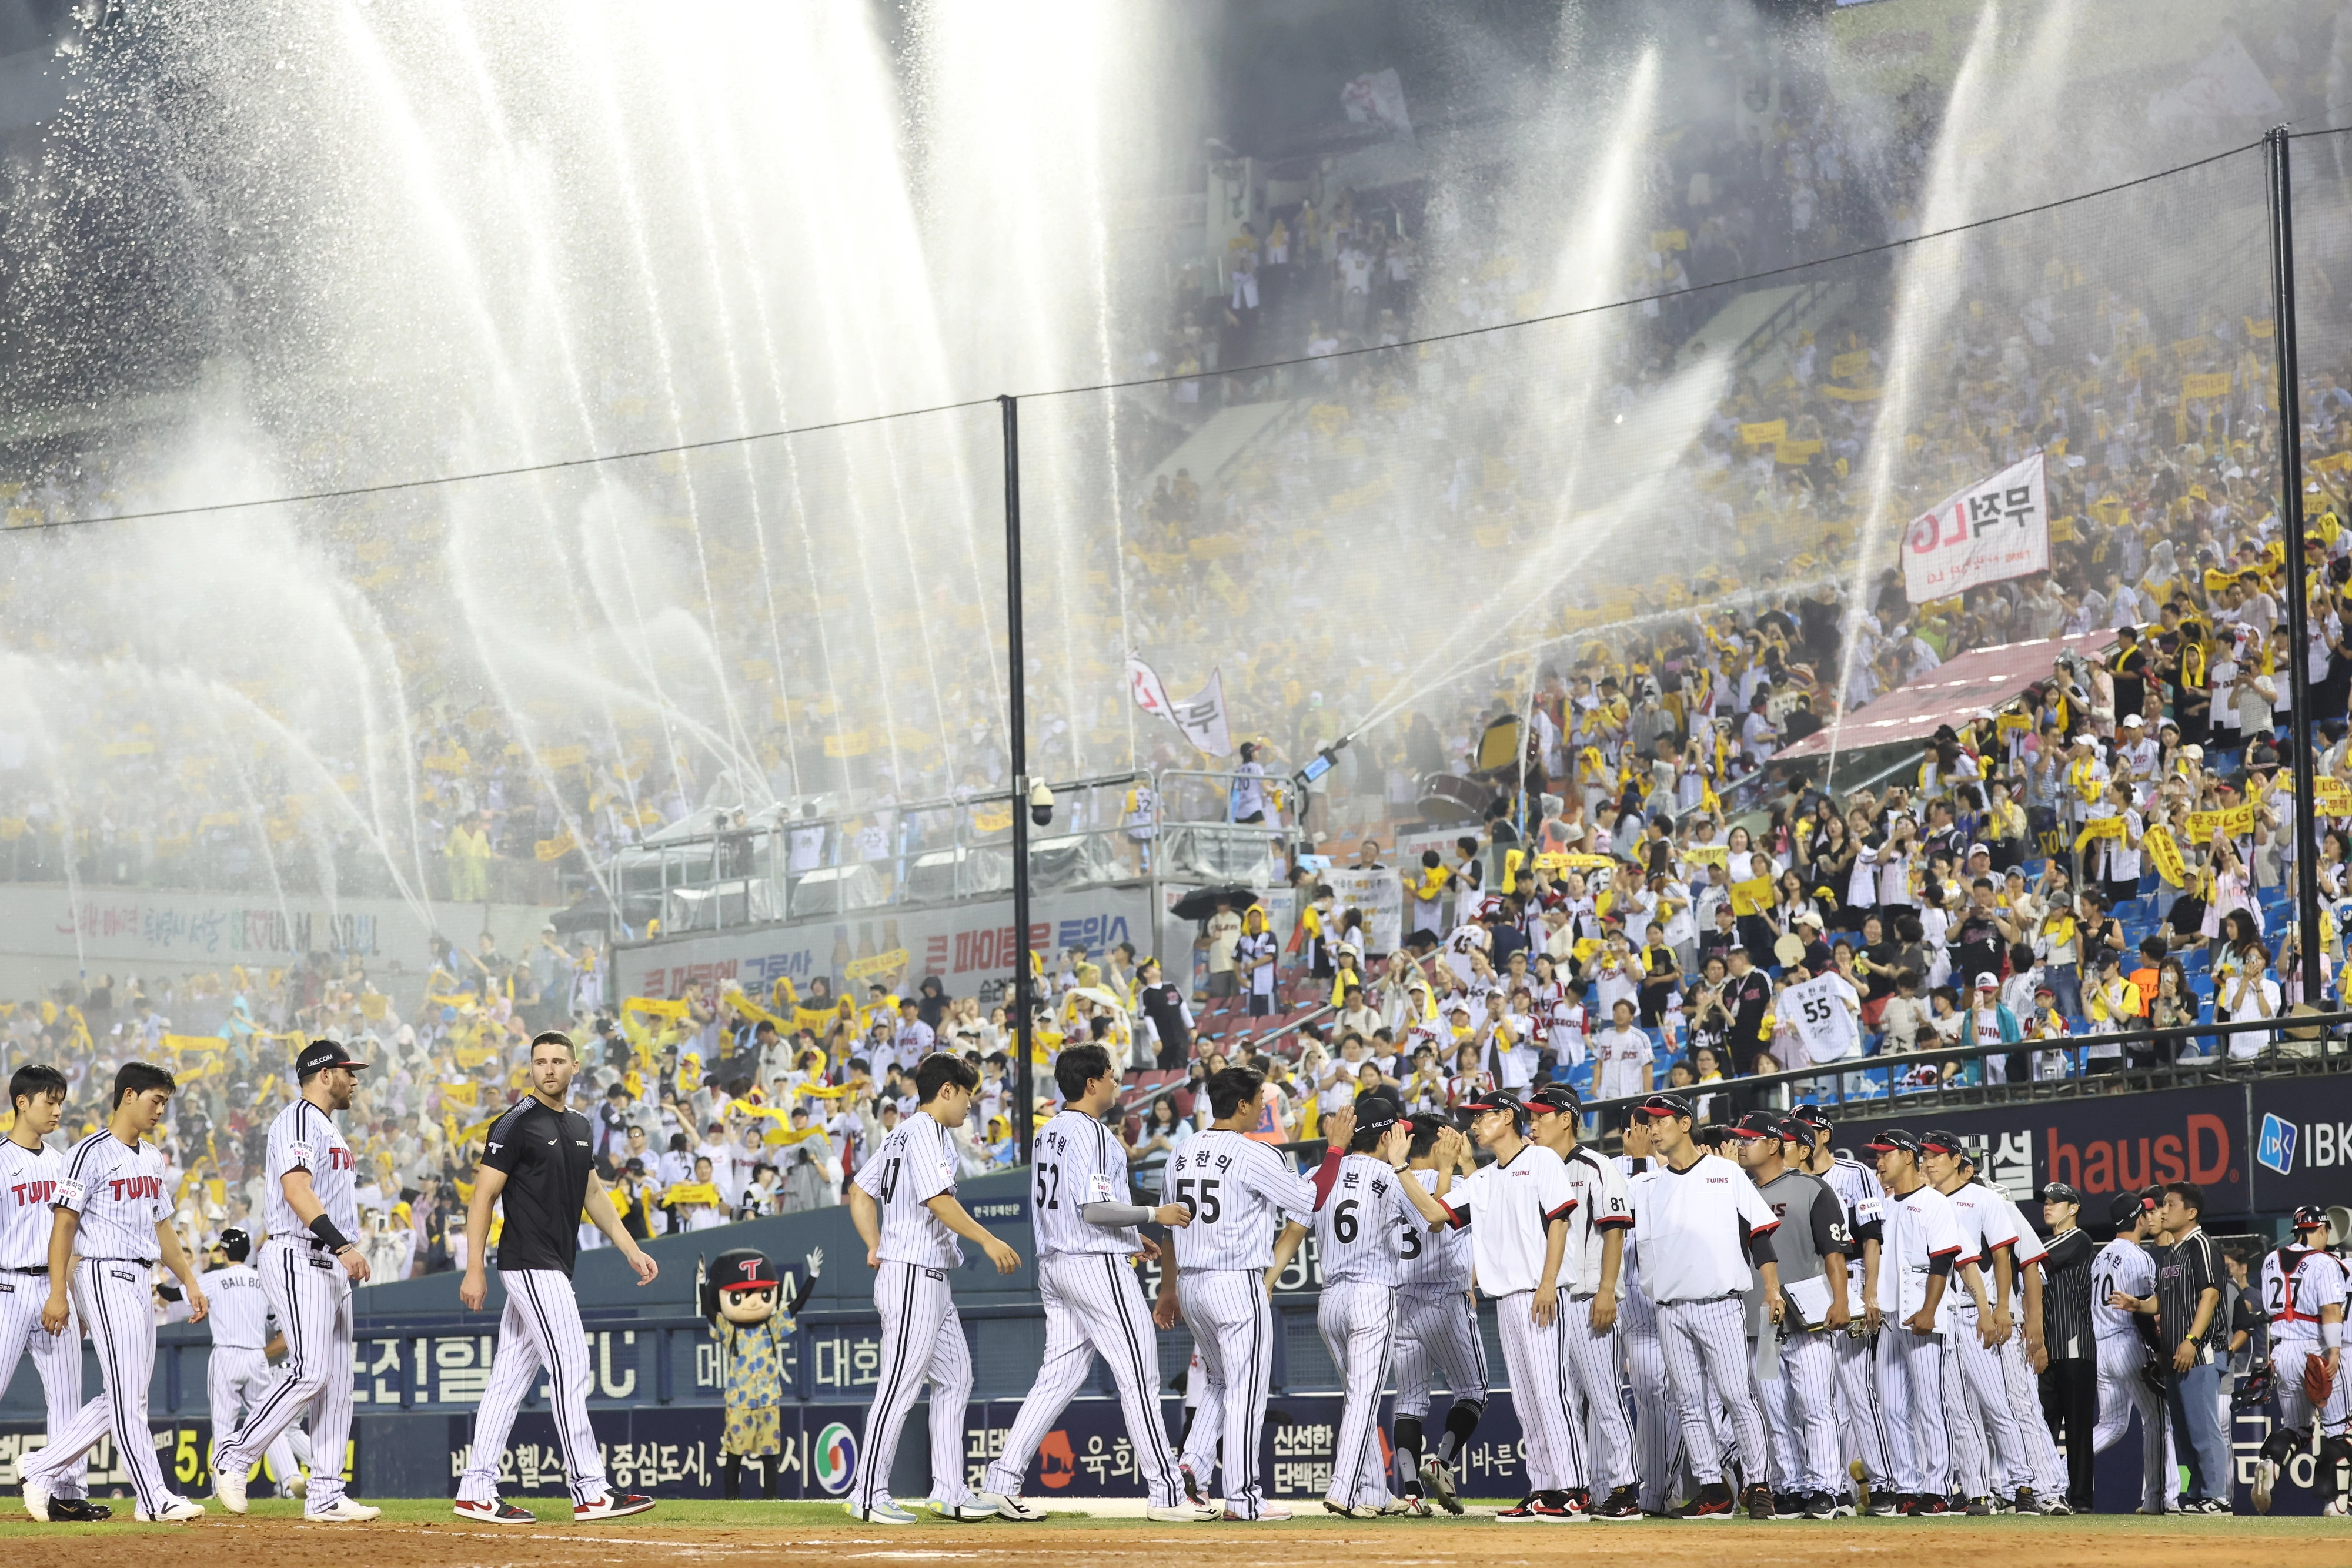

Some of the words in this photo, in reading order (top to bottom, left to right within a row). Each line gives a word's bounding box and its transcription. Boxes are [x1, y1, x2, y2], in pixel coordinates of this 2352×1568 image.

[2223, 811, 2249, 826] LG
[1803, 998, 1831, 1023] 55
[307, 1054, 333, 1068] LGE.COM
[1498, 1096, 1522, 1114] LGE.COM
[1372, 1118, 1394, 1128] LGE.COM
[1175, 1150, 1233, 1175] 송찬의
[2047, 1113, 2230, 1194] hausD
[108, 1176, 163, 1201] TWIN
[881, 1158, 901, 1205] 41
[1037, 1162, 1060, 1209] 52
[974, 1203, 1021, 1218] 한국경제신문
[1176, 1178, 1221, 1225] 55
[1611, 1197, 1626, 1212] 81
[1334, 1199, 1360, 1245] 6
[739, 1258, 763, 1281] T
[220, 1277, 245, 1290] BALL
[2094, 1273, 2114, 1307] 10
[1273, 1423, 1334, 1457] 신선한
[1470, 1441, 1518, 1477] 바른
[1273, 1461, 1334, 1494] 단백질
